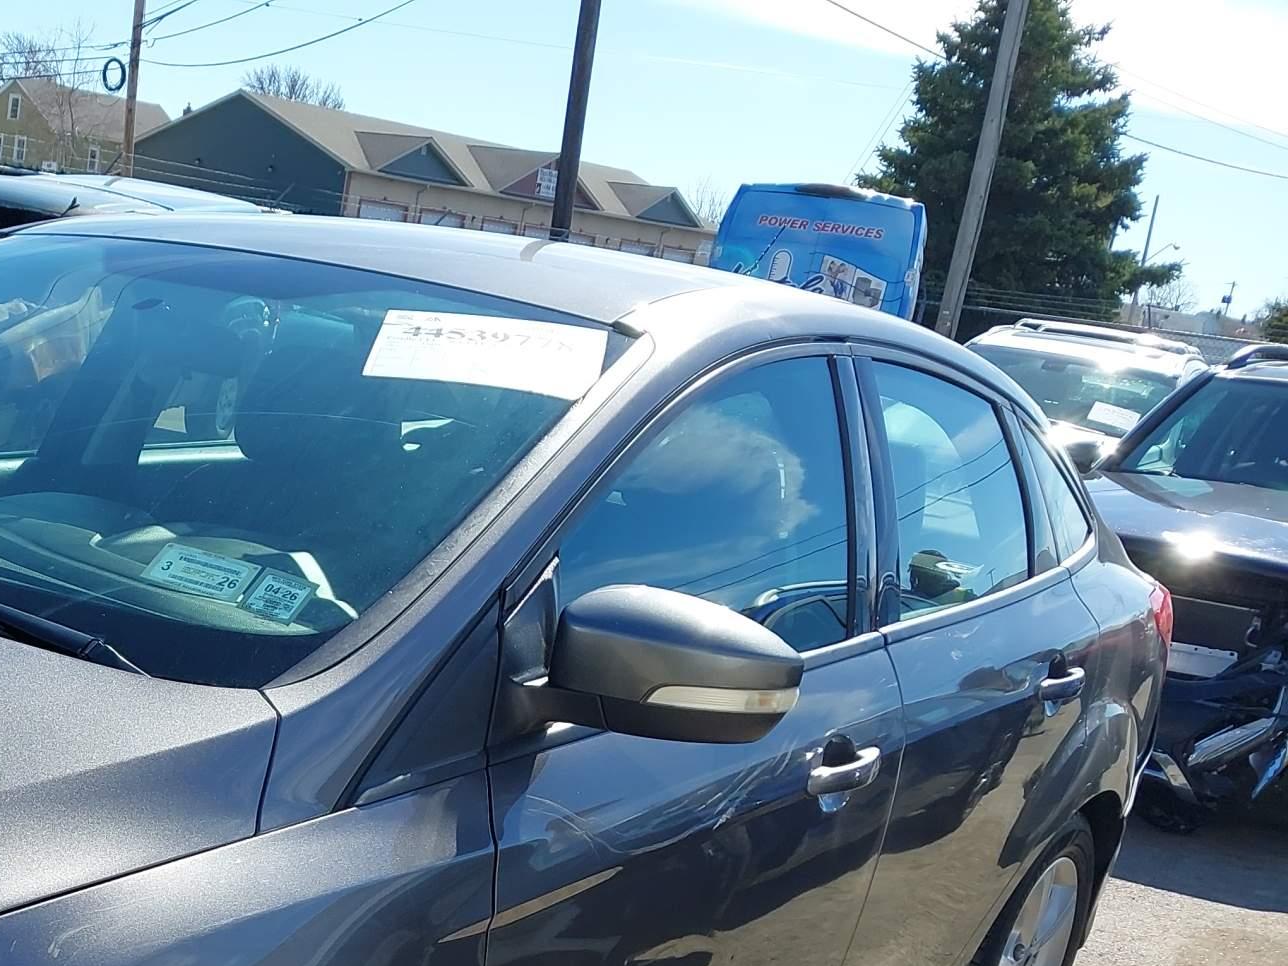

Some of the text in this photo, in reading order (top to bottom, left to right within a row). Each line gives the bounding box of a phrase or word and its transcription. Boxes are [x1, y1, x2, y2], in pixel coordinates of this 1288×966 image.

[758, 214, 885, 240] POWER SERVICES
[161, 560, 173, 571] 3
[216, 576, 240, 589] 26
